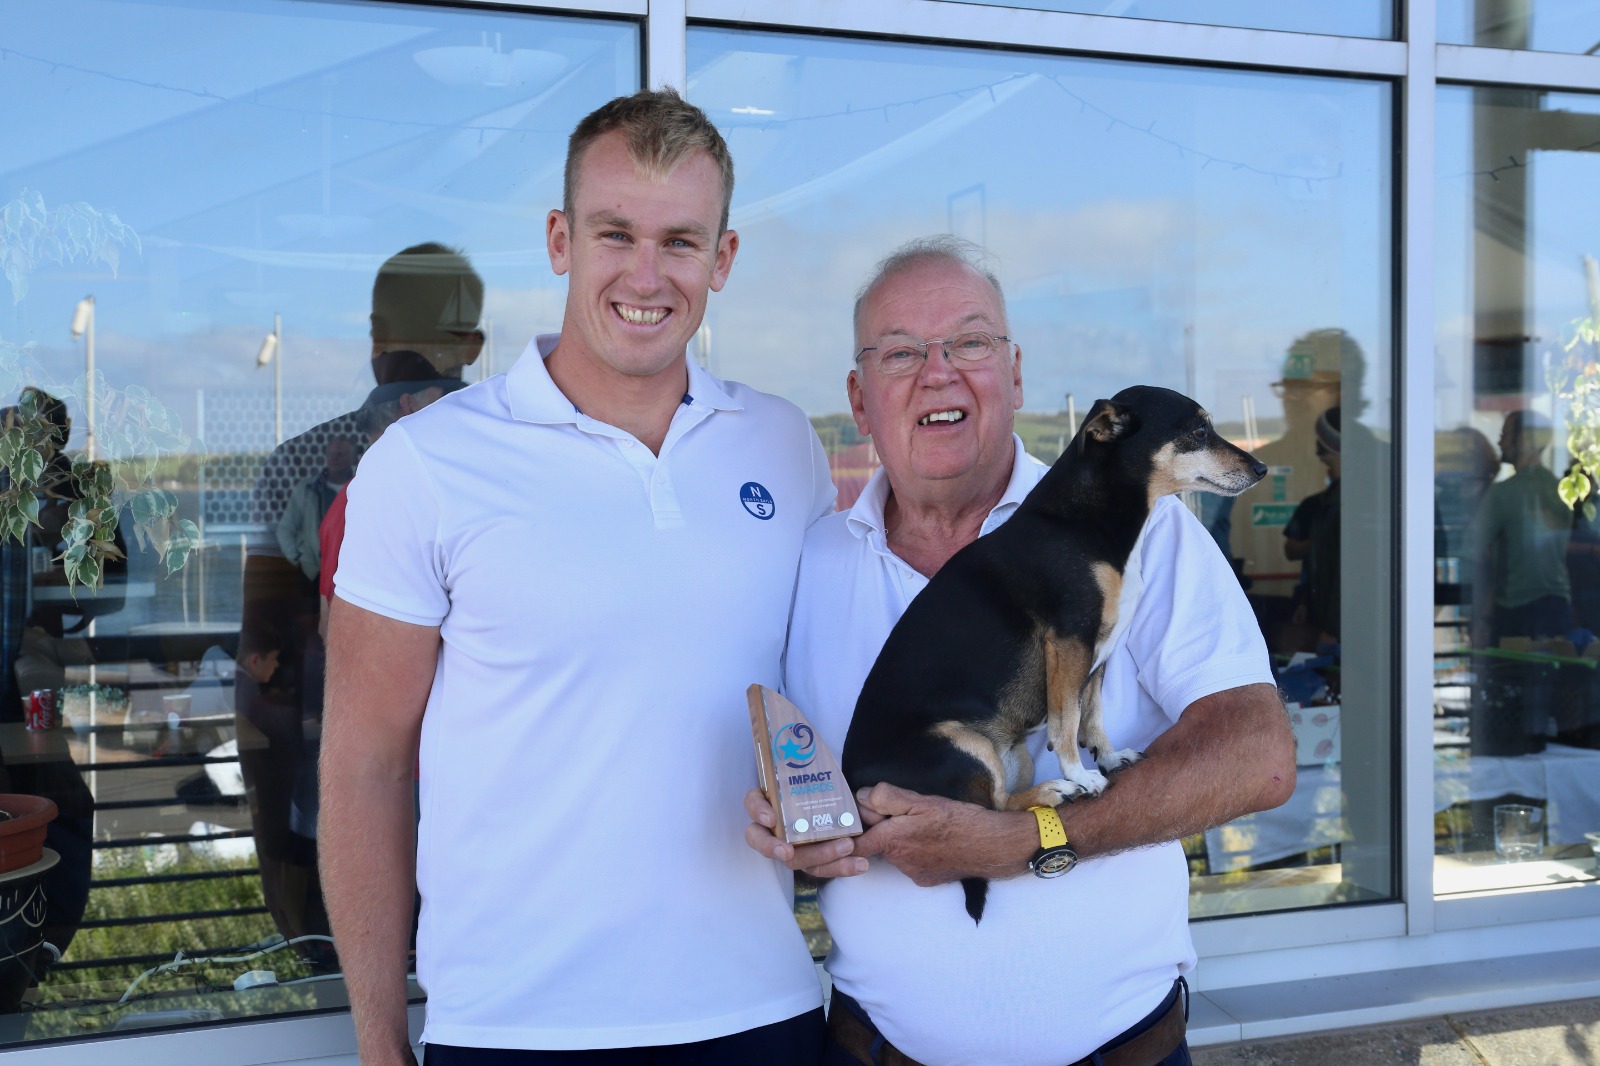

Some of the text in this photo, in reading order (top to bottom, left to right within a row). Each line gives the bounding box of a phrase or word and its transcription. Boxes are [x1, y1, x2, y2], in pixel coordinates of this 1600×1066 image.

[750, 486, 761, 498] N
[756, 504, 766, 515] S
[788, 771, 832, 785] IMPACT
[790, 782, 835, 796] AWARDS
[812, 813, 833, 827] RYA
